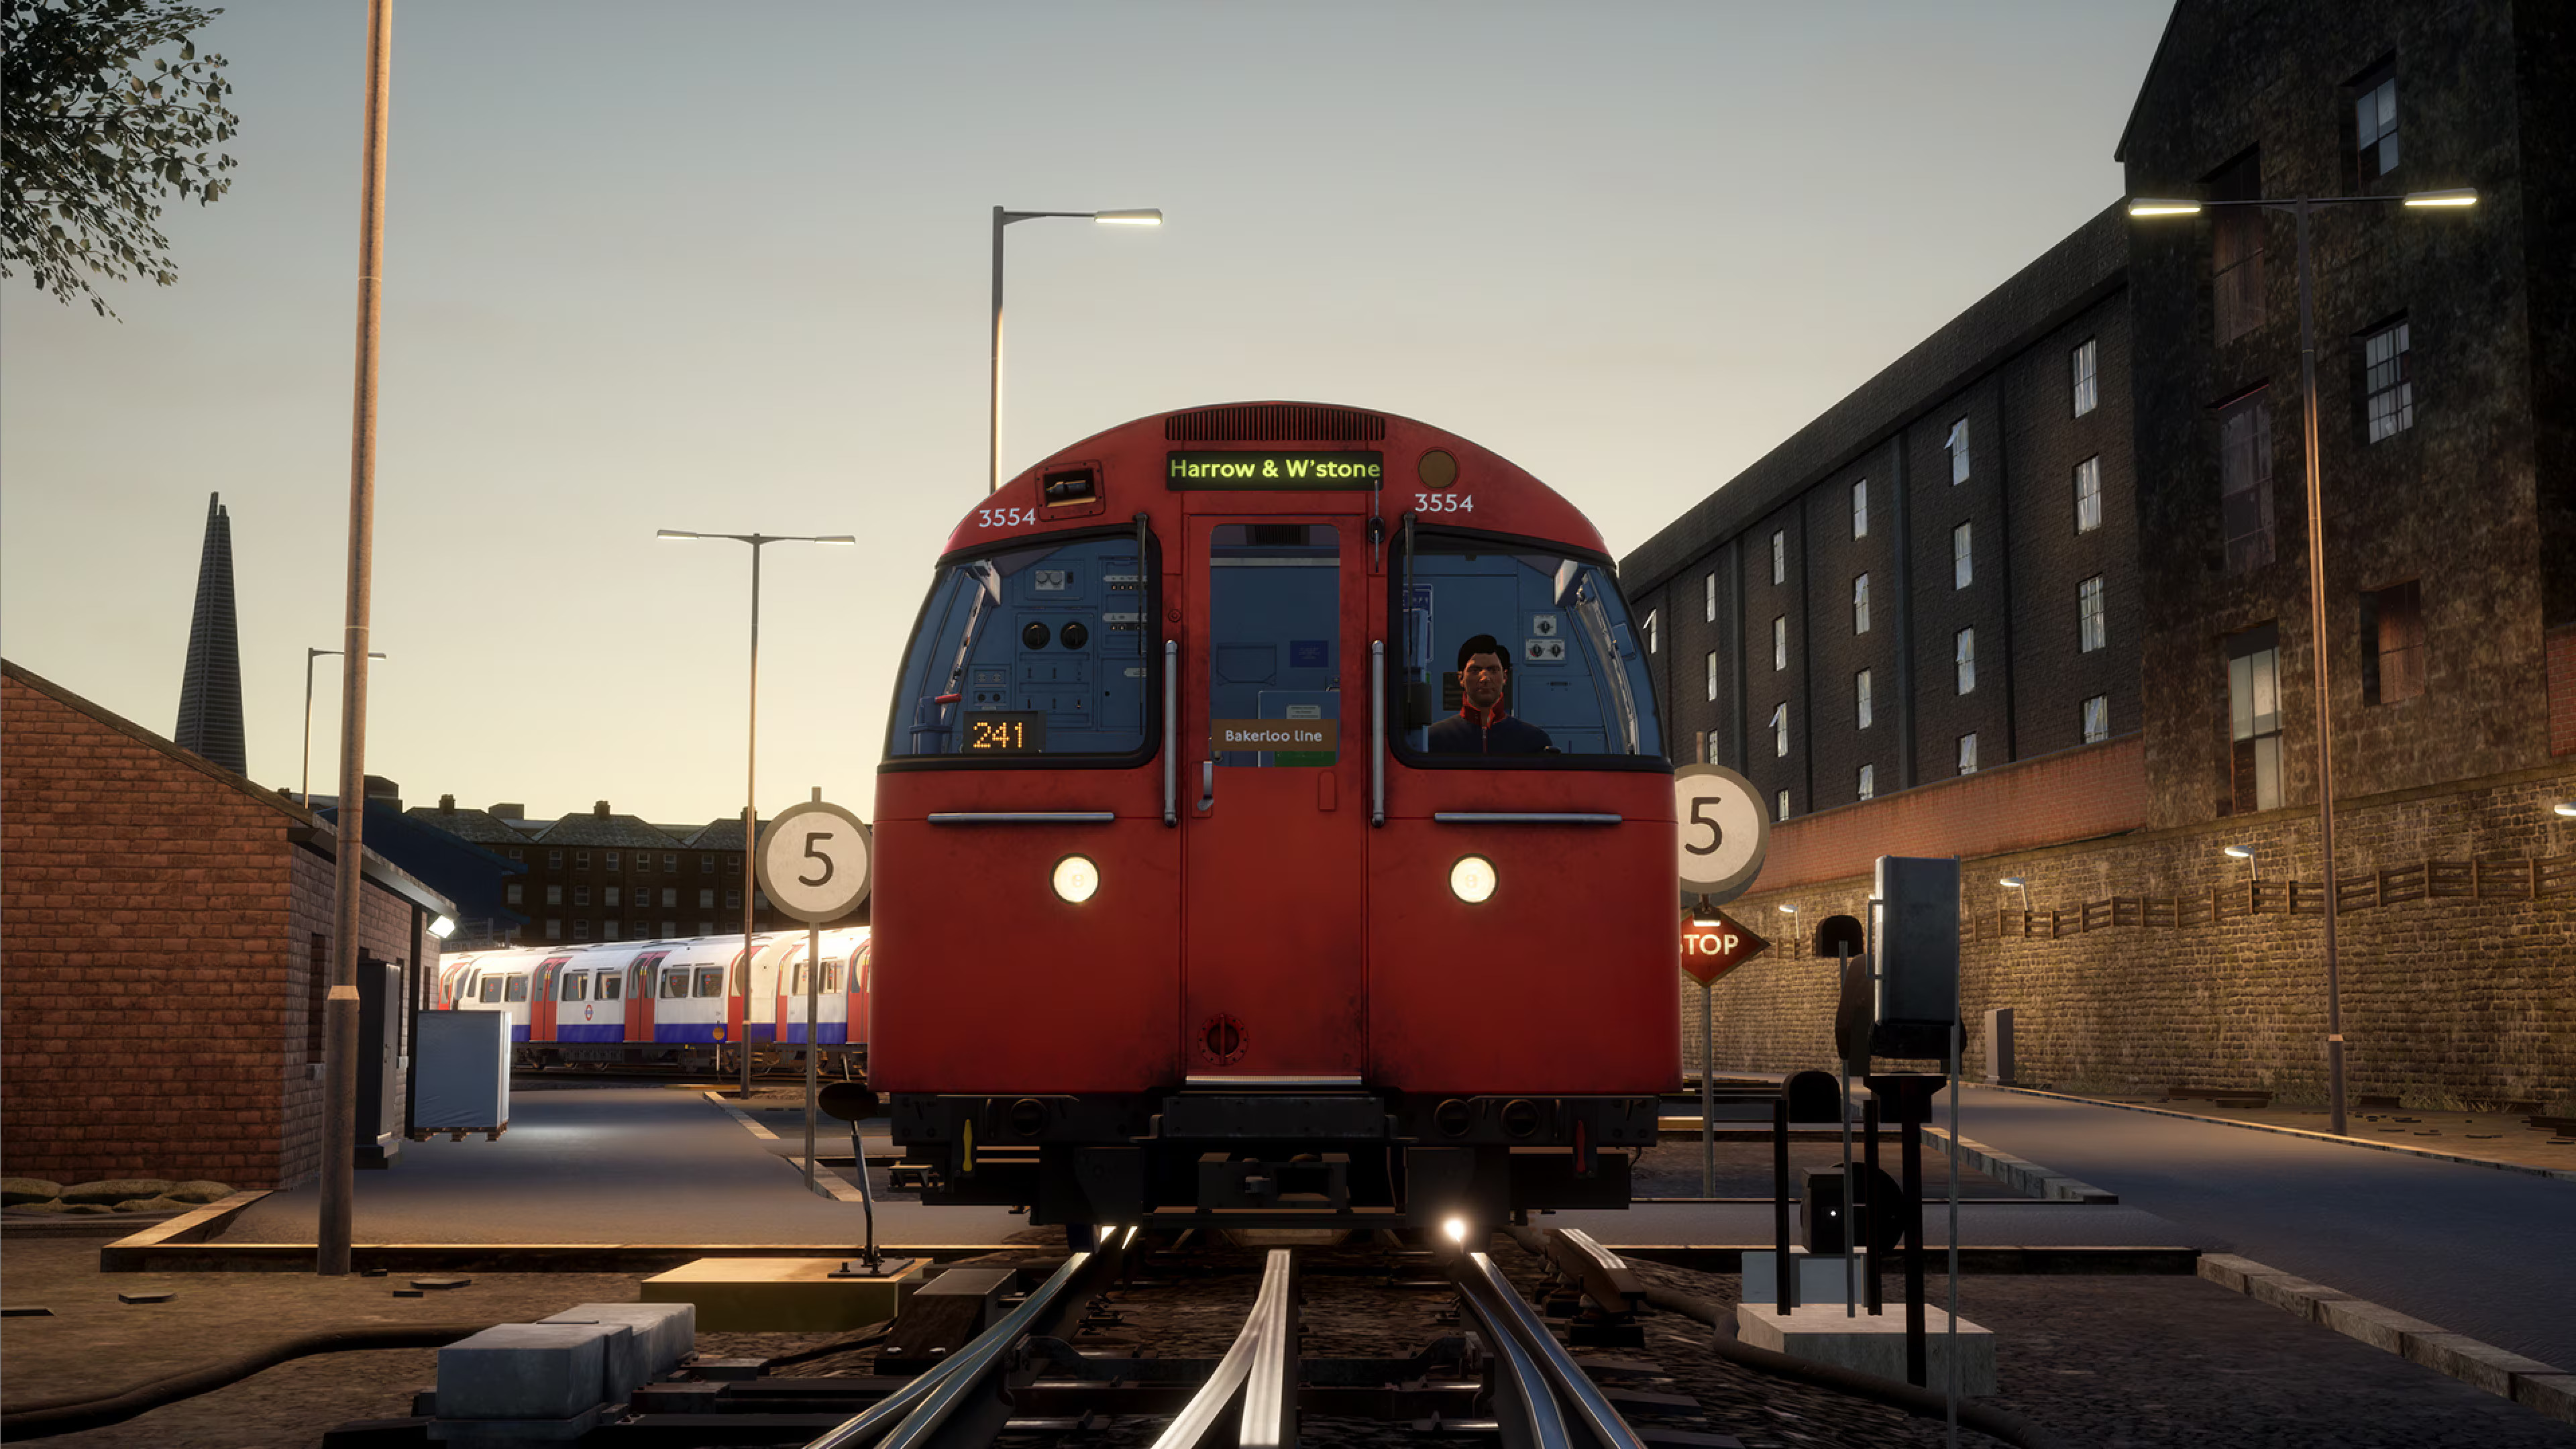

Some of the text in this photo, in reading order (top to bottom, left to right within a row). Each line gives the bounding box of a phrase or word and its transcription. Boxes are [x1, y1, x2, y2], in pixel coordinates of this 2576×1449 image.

[1171, 460, 1256, 478] Harrow
[1262, 460, 1279, 478] &
[1415, 493, 1474, 513] 3554
[979, 508, 1036, 528] 3554
[973, 721, 1022, 749] 241
[1225, 729, 1323, 742] Bakerloo line
[1684, 796, 1723, 855] 5
[798, 832, 834, 887] 5
[1680, 933, 1739, 956] TOP
